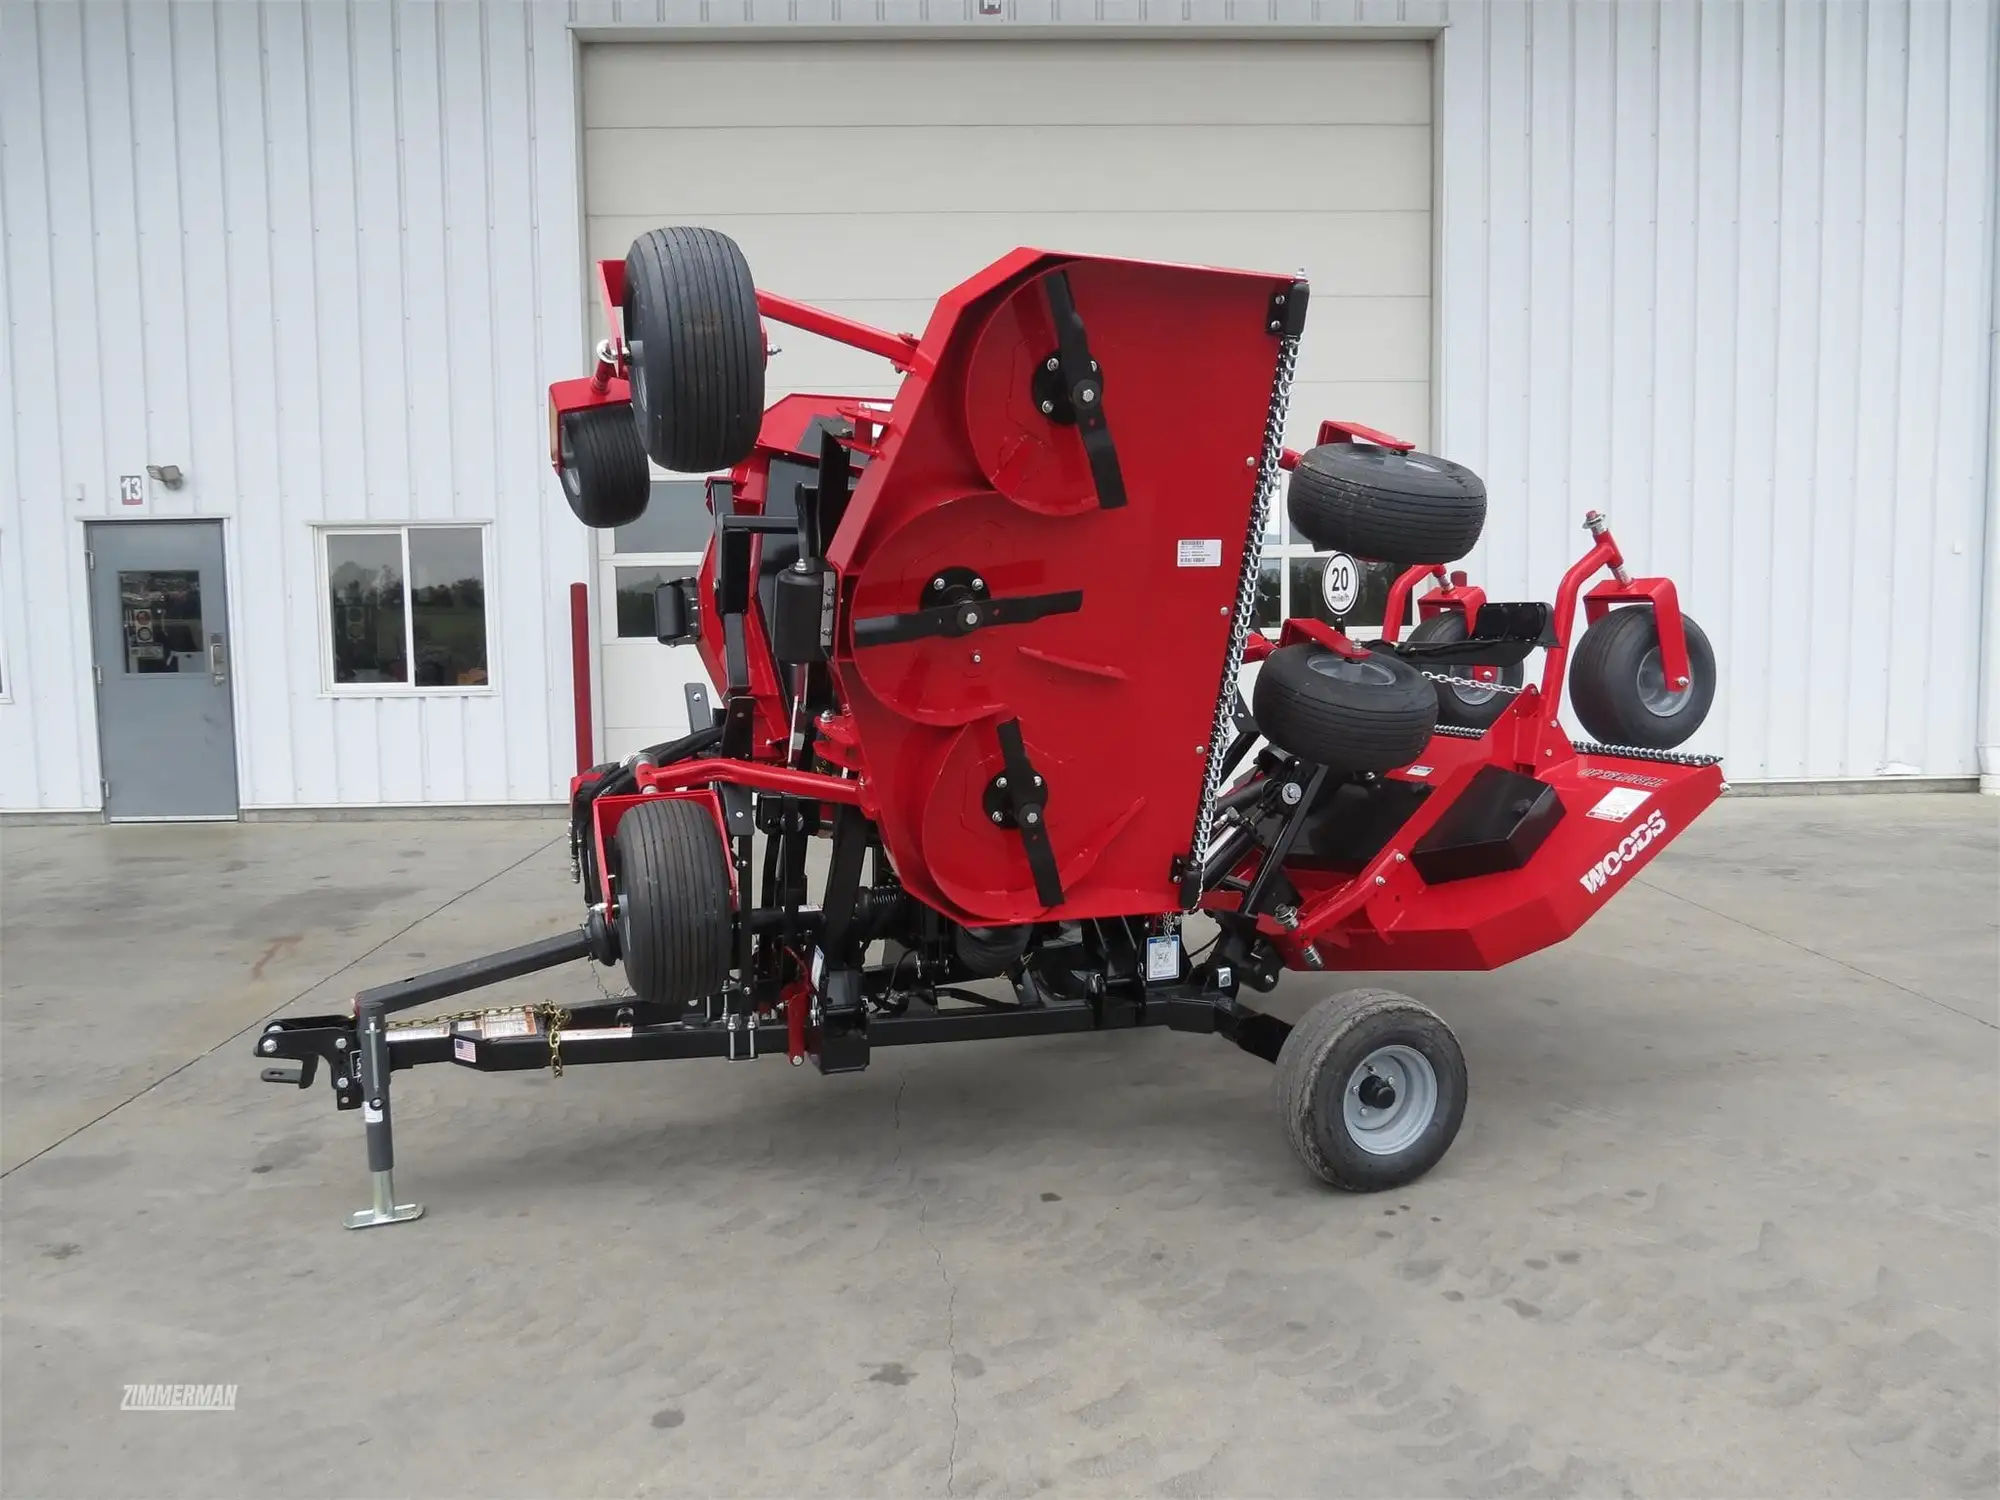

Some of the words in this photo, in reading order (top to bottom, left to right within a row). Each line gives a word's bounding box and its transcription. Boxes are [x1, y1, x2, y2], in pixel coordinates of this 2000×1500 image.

[121, 477, 142, 500] 13
[1332, 567, 1348, 591] 20
[1580, 808, 1666, 895] WOODS
